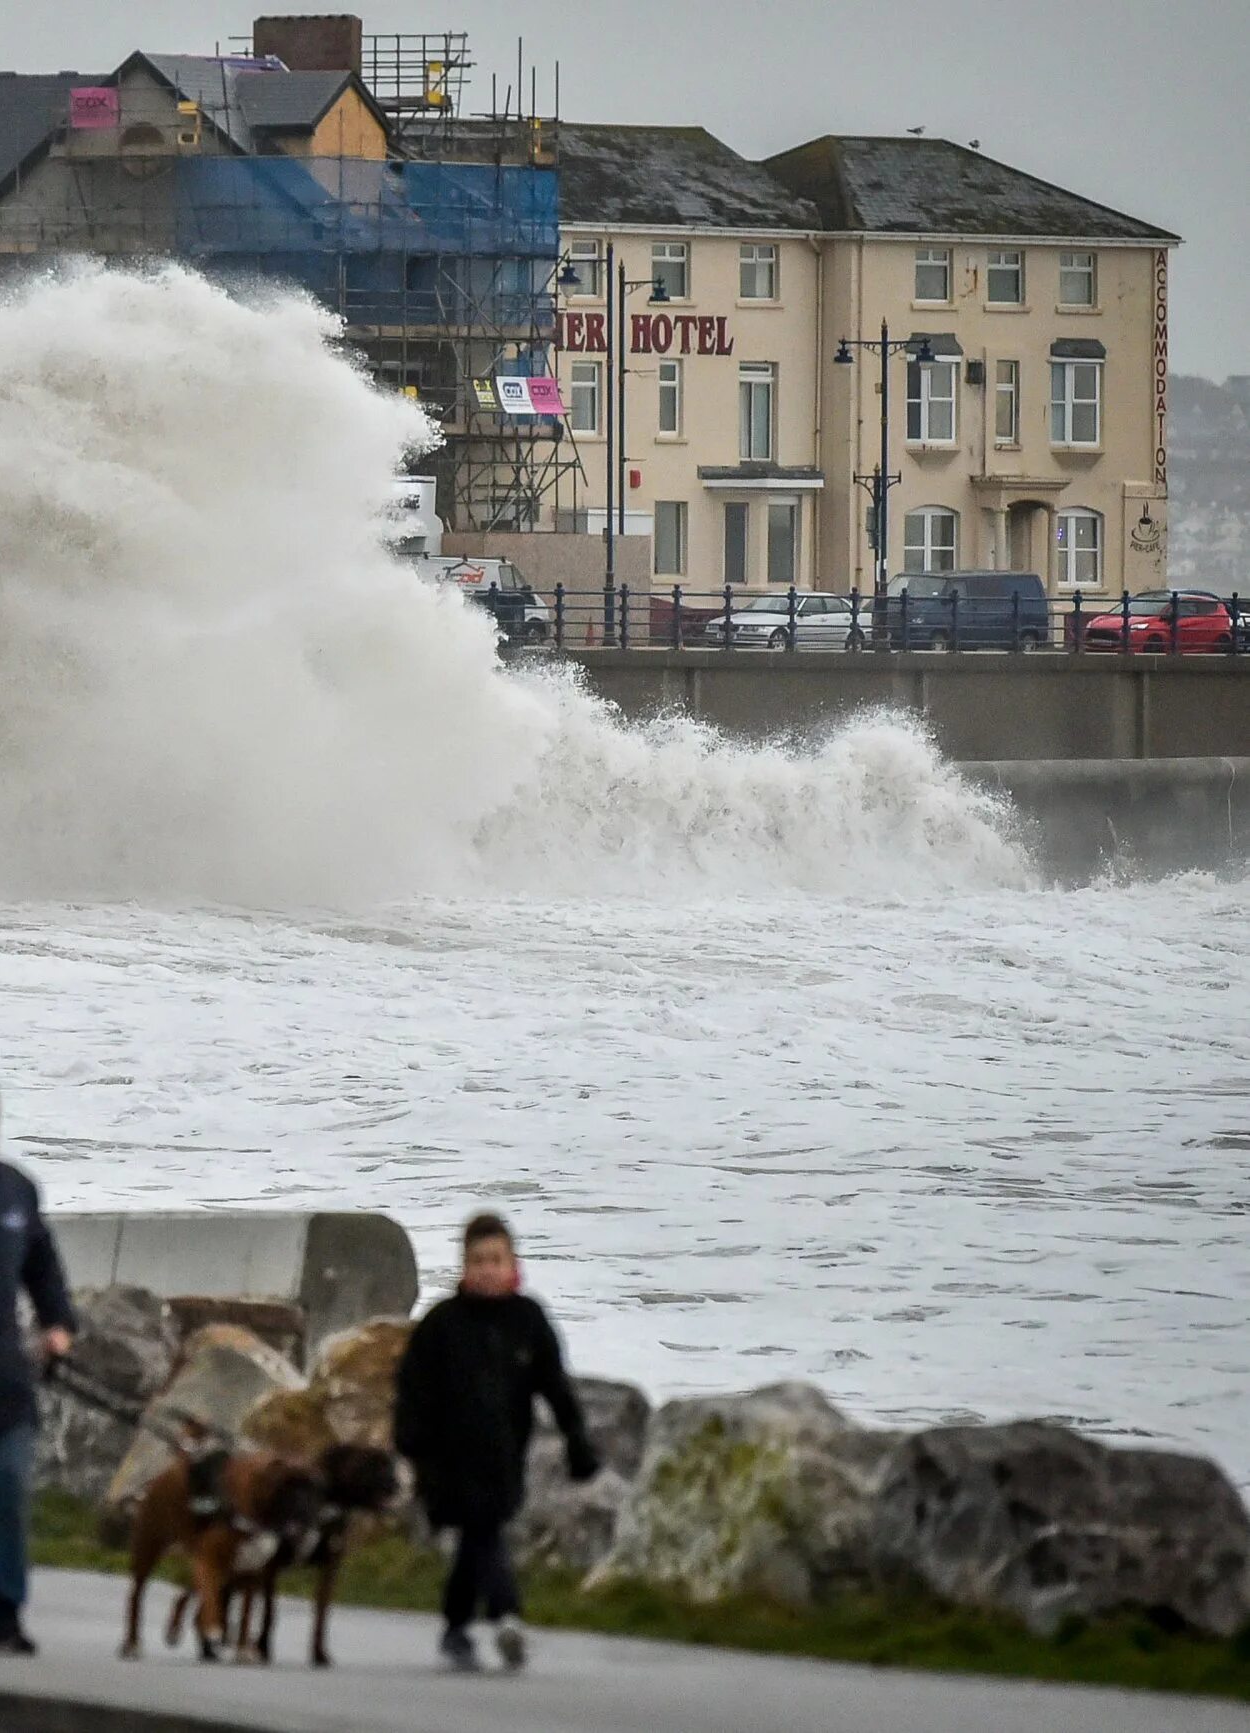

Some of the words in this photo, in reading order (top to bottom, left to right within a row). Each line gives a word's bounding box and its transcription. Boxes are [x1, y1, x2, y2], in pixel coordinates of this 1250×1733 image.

[554, 312, 607, 352] IER
[630, 314, 734, 356] HOTEL
[1154, 250, 1168, 485] ACCOMMODATION
[504, 385, 522, 397] COX
